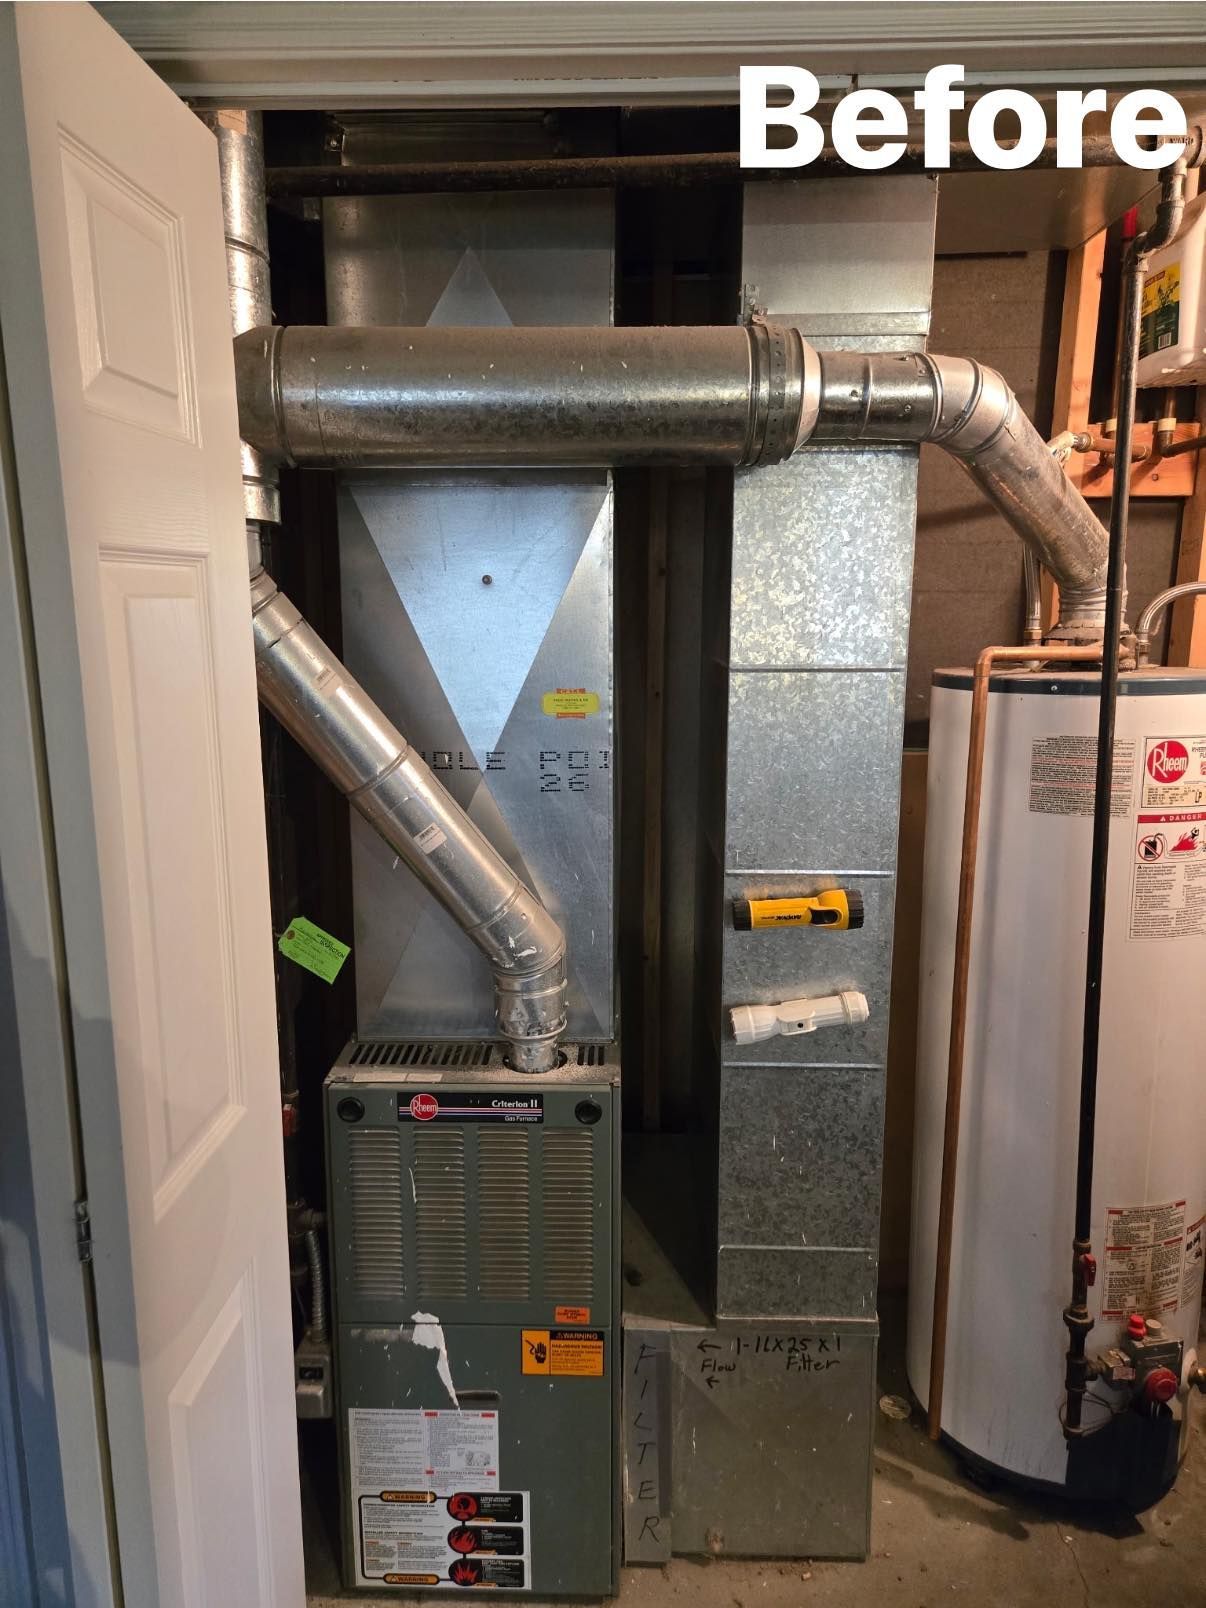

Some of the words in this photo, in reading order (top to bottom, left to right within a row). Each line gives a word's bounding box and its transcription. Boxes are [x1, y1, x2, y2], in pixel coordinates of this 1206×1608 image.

[1151, 741, 1188, 779] Rheem
[539, 773, 590, 793] 26
[1169, 813, 1202, 821] DANGER
[411, 1094, 438, 1118] Rheem
[491, 1099, 528, 1109] Criterion
[563, 1332, 598, 1340] WARNING
[700, 1358, 737, 1373] Flow
[785, 1353, 841, 1372] Filter
